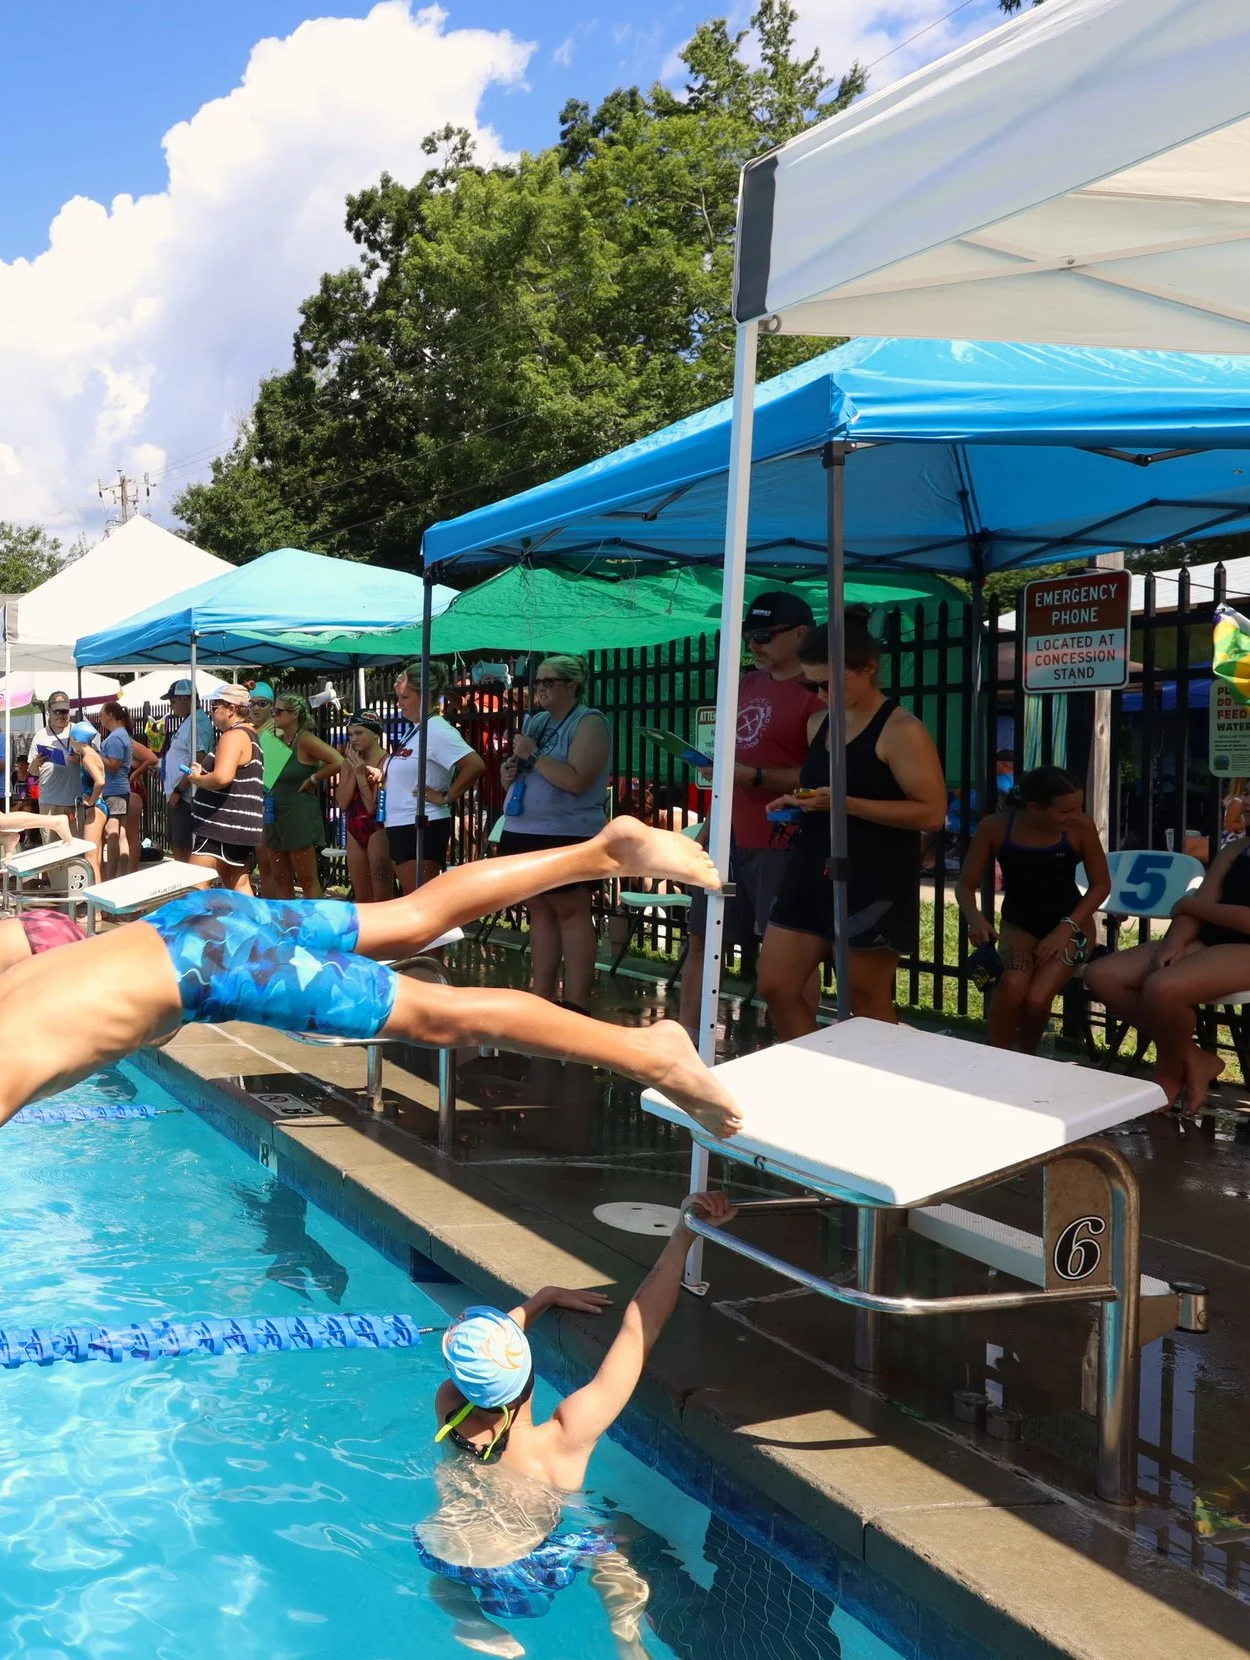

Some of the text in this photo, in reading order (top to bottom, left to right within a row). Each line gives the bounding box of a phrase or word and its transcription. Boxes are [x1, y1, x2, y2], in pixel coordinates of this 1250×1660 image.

[1035, 583, 1118, 608] EMERGENCY
[1052, 607, 1099, 626] PHONE
[1036, 633, 1116, 651] LOCATED AT
[1035, 649, 1116, 667] CONCESSION
[1053, 666, 1095, 680] STAND
[1217, 709, 1247, 719] FEED
[69, 874, 86, 890] 3
[1119, 854, 1174, 911] 5
[1053, 1215, 1106, 1280] 6
